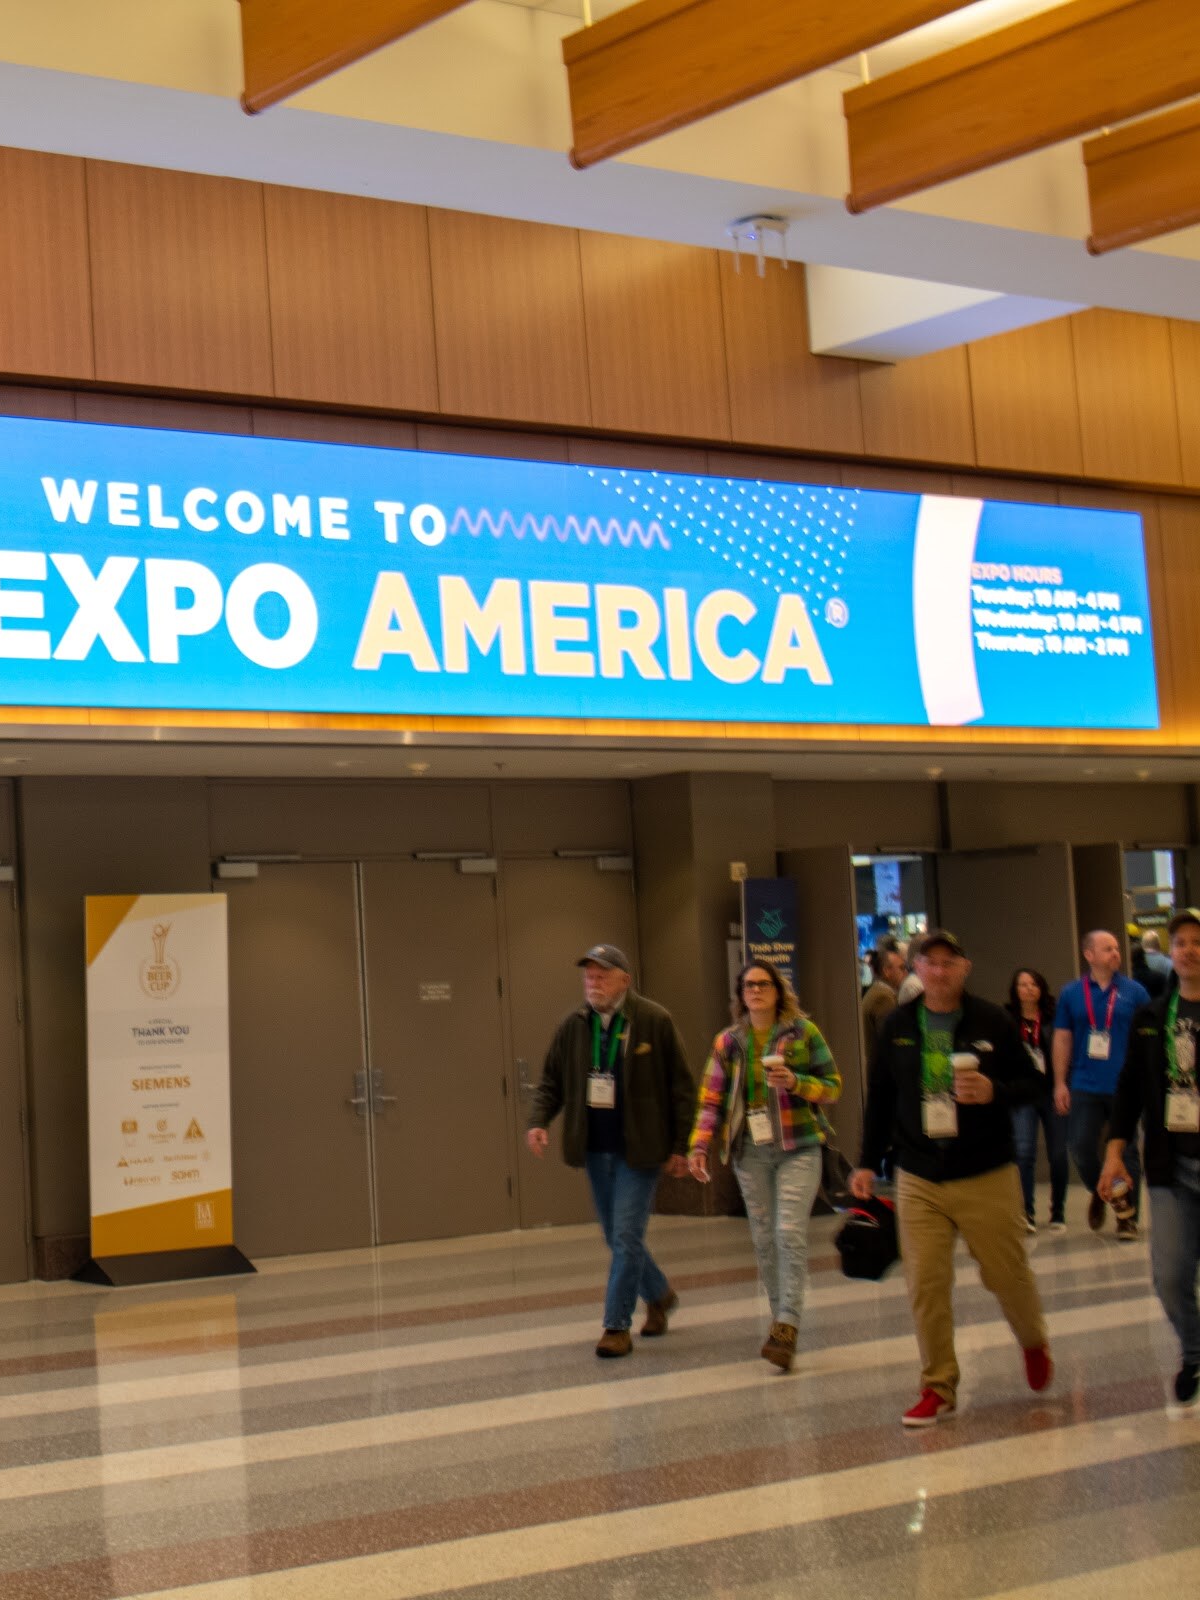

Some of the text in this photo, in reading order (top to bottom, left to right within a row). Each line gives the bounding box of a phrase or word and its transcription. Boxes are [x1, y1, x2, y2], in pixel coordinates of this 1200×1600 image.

[41, 477, 446, 546] WELCOME TO
[971, 563, 1062, 585] EXPO HOURS
[748, 942, 795, 953] Trade Show
[132, 1025, 190, 1037] THANK YOU
[131, 1076, 191, 1092] SIEMENS
